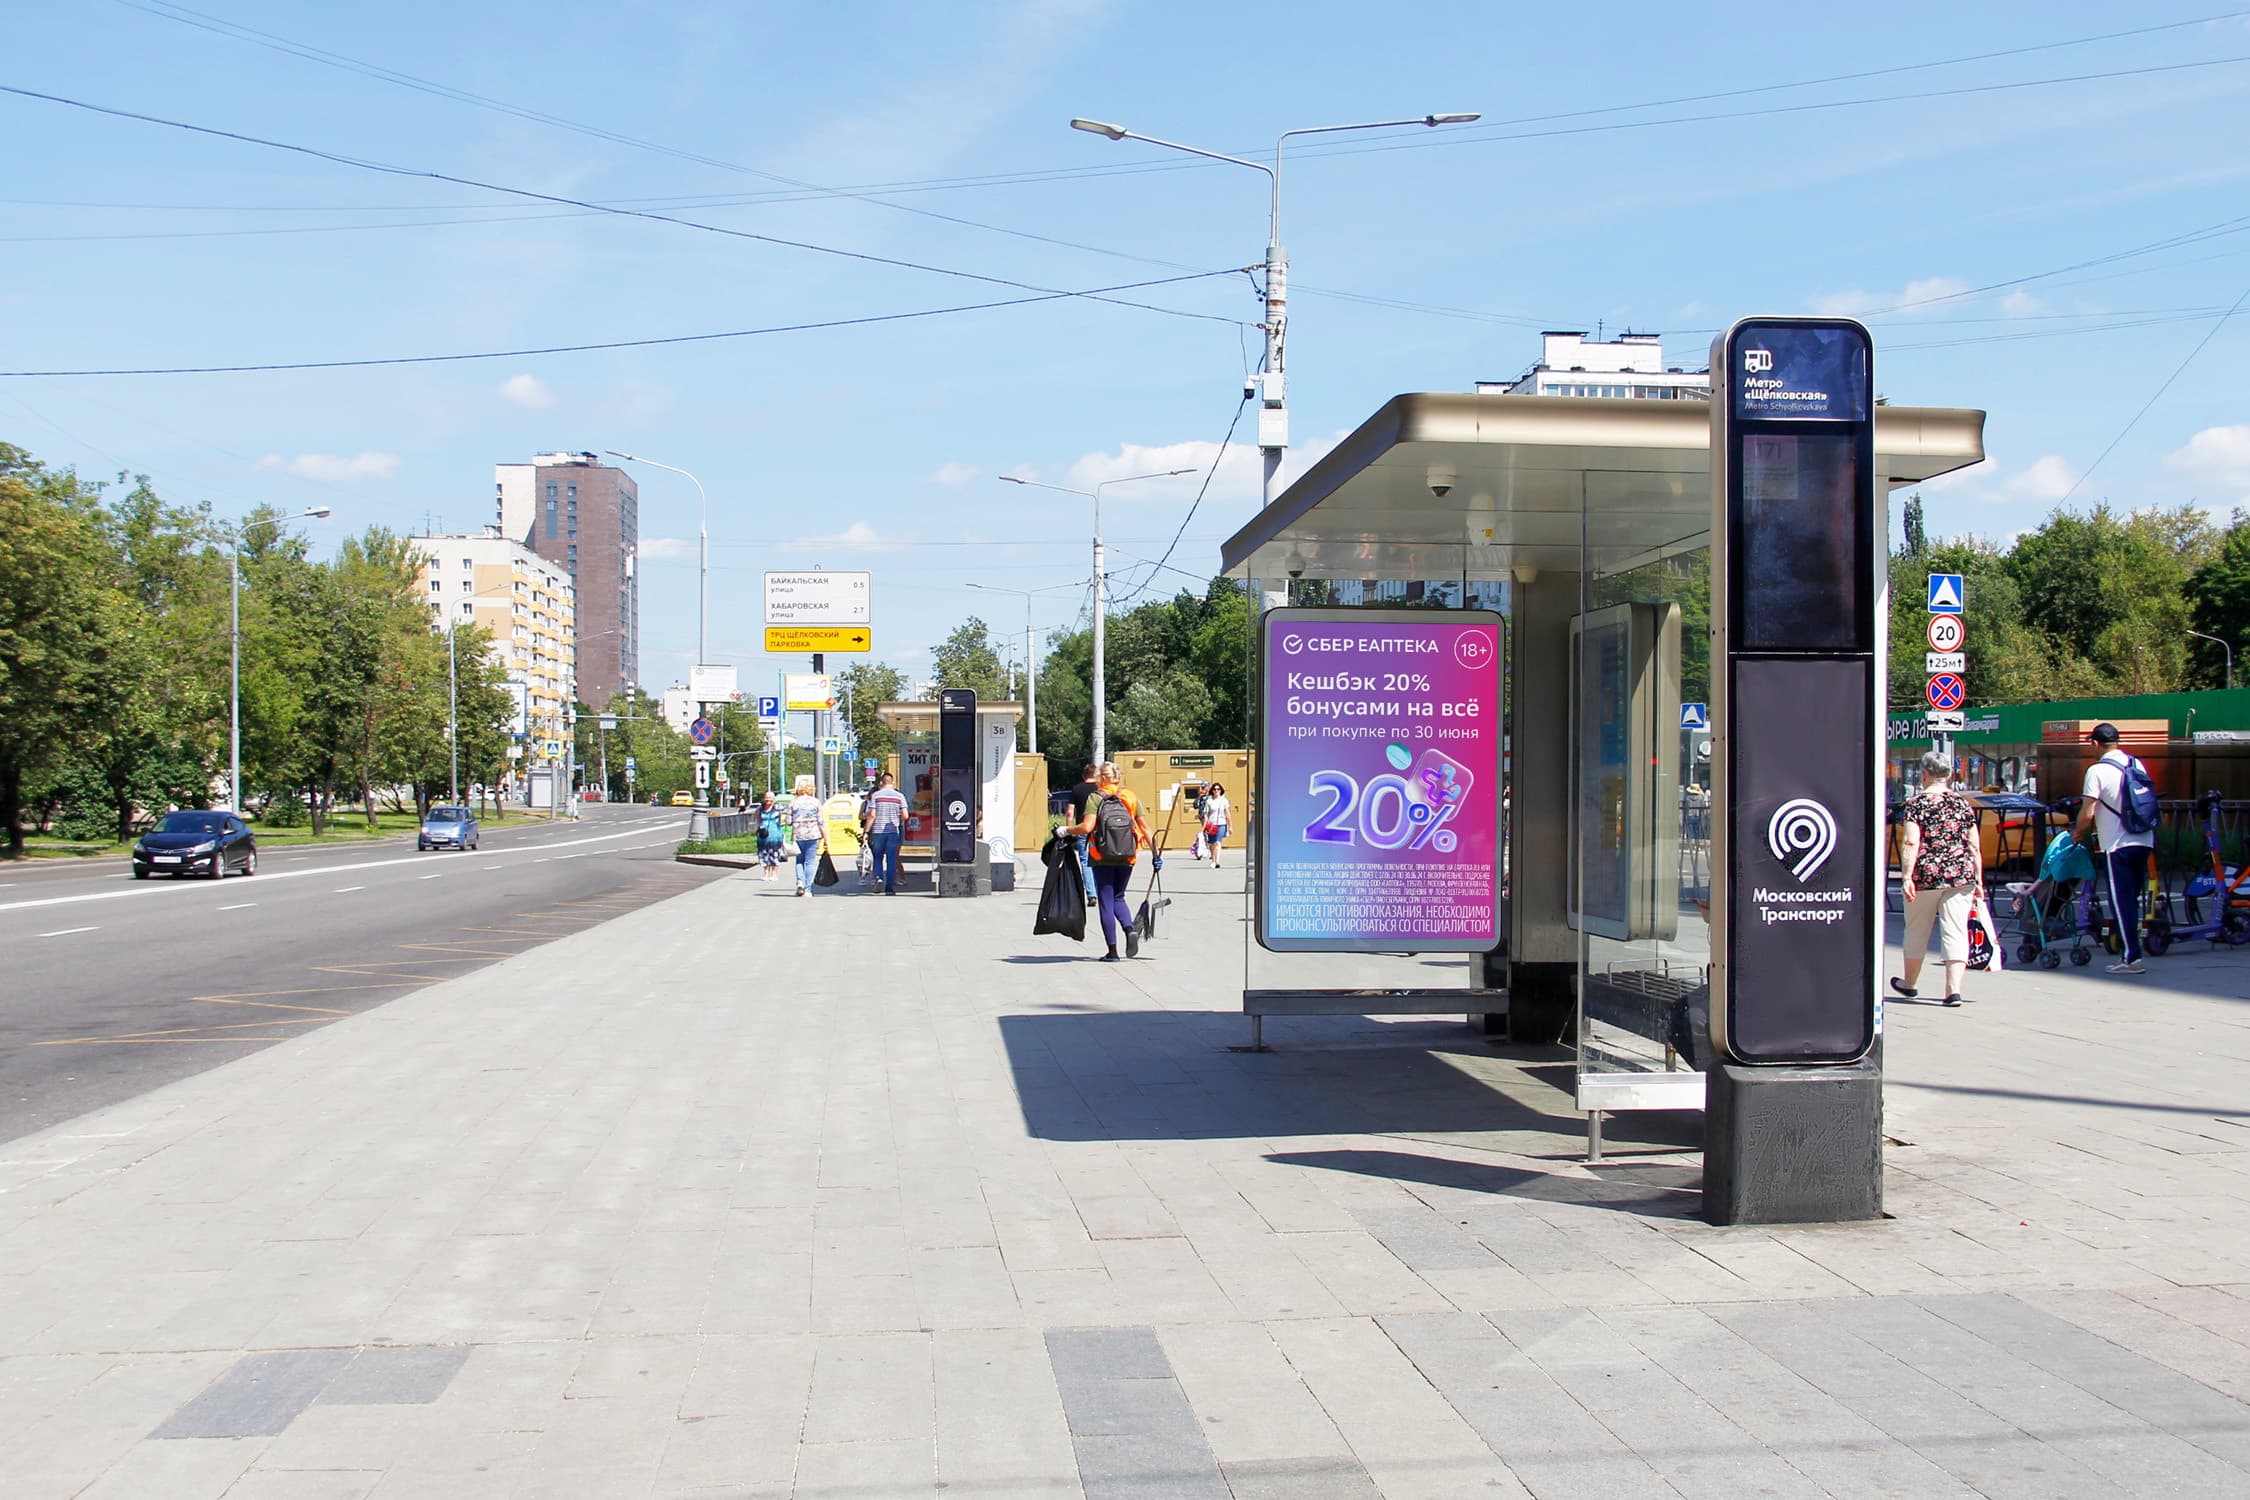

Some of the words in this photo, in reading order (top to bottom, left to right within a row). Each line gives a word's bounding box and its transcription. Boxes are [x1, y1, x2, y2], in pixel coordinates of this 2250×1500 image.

[1744, 377, 1783, 389] Метро
[1744, 389, 1827, 401] «Щёлковская»
[1744, 402, 1769, 410] Metro
[770, 576, 829, 585] БАЙКАЛЬСКАЯ
[770, 602, 830, 610] ХАБАРОВСКАЯ
[770, 631, 785, 639] ТРЦ
[1935, 625, 1956, 641] 20
[1307, 637, 1354, 652] СБЕР
[1358, 639, 1440, 653] ЕАПТЕКА
[1461, 643, 1488, 657] 18+
[1288, 671, 1377, 691] Кешбэк
[1383, 673, 1431, 692] 20%
[1287, 696, 1400, 719] бонусами
[1407, 702, 1434, 716] на
[1441, 698, 1480, 717] всё
[1288, 726, 1317, 740] при
[1322, 727, 1386, 740] покупке
[1391, 727, 1410, 739] по
[1414, 726, 1434, 739] 30
[1438, 728, 1479, 739] июня
[907, 753, 928, 765] ХИТ
[1302, 769, 1458, 853] 20%
[1752, 887, 1852, 902] Московский
[1276, 904, 1321, 918] ИМЕЮТСЯ
[1322, 904, 1425, 918] ПРОТИВОПОКАЗАНИЯ.
[1426, 905, 1491, 919] НЕОБХОДИМО
[1759, 906, 1845, 925] Транспорт
[1276, 918, 1397, 932] ПРОКОНСУЛЬТИРОВАТЬСЯ
[1398, 919, 1412, 932] СО
[1412, 919, 1491, 934] СПЕЦИАЛИСТОМ
